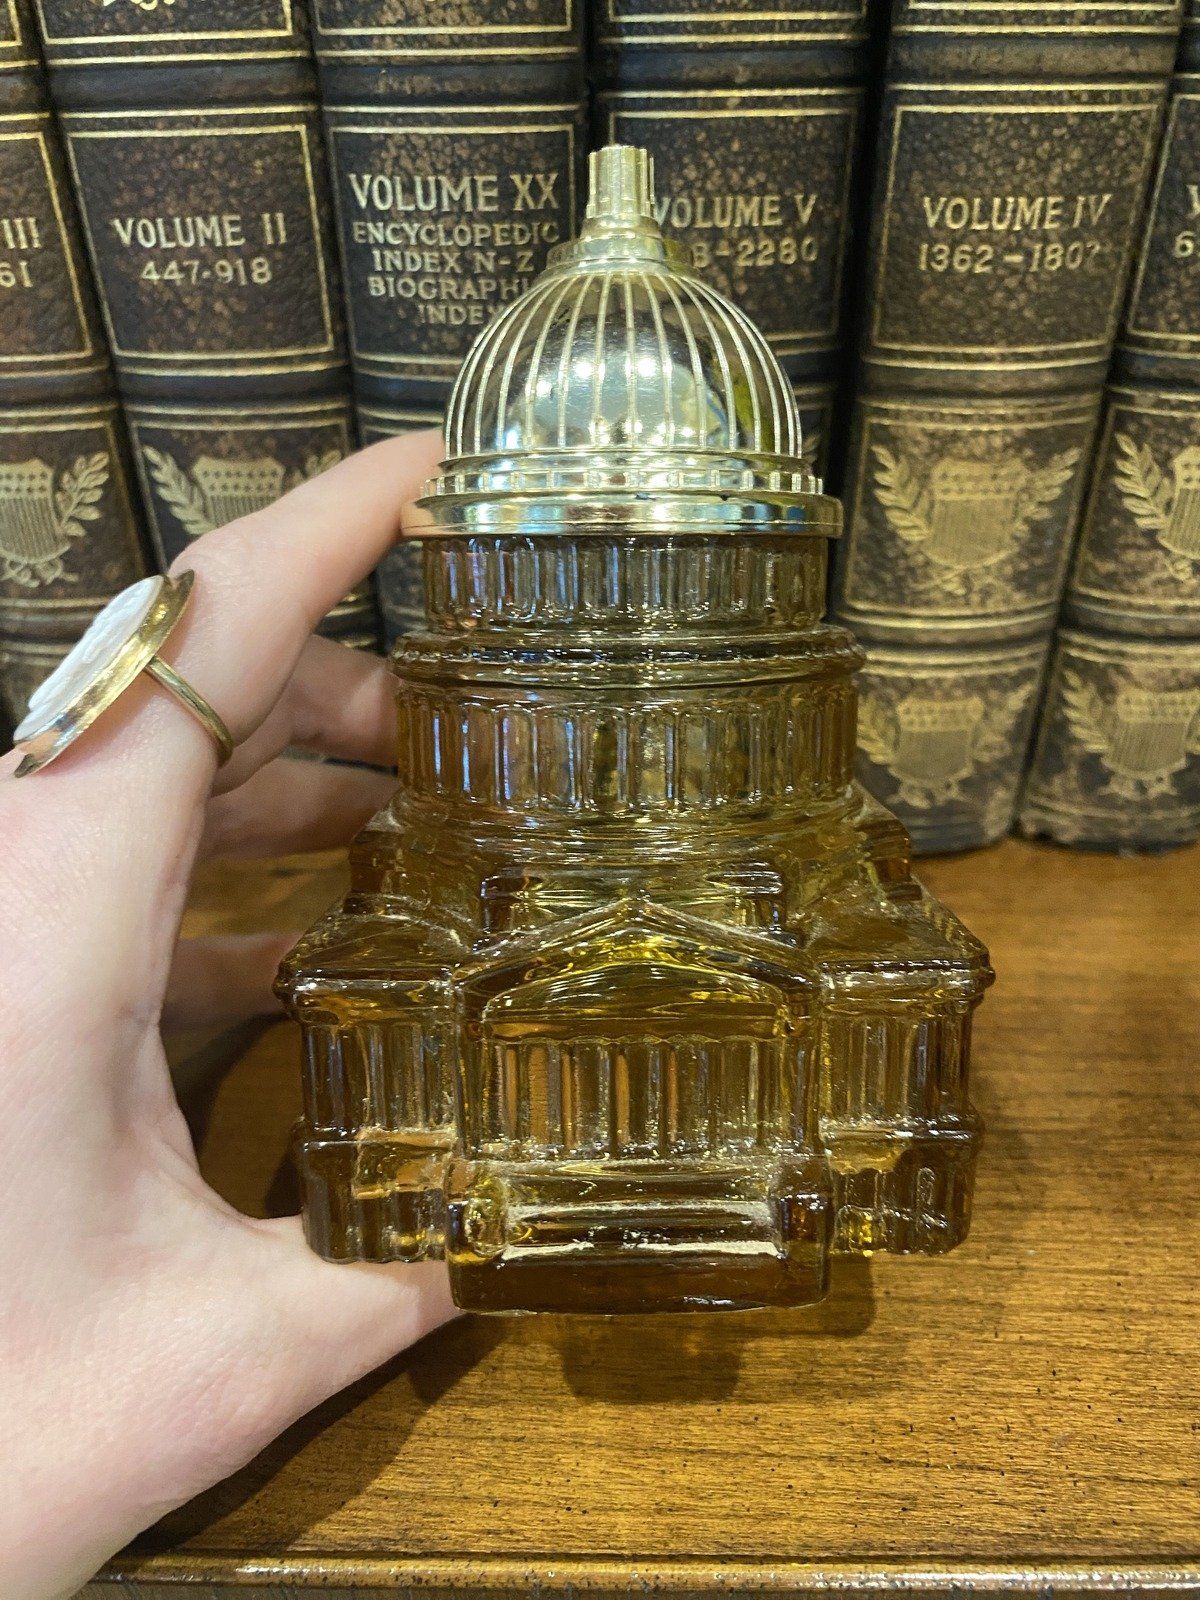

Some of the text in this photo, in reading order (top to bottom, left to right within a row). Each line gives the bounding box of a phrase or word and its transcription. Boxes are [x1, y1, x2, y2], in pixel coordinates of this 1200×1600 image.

[349, 172, 559, 212] VOLUME XX
[654, 193, 818, 228] VOLUME V
[923, 193, 1112, 230] VOLUME IV
[110, 212, 288, 248] VOLUME II
[352, 221, 560, 247] ENCYCLOPEDIC
[371, 250, 462, 274] INDEX
[692, 236, 819, 268] 8-2280
[367, 276, 530, 300] BIOGRAPHI
